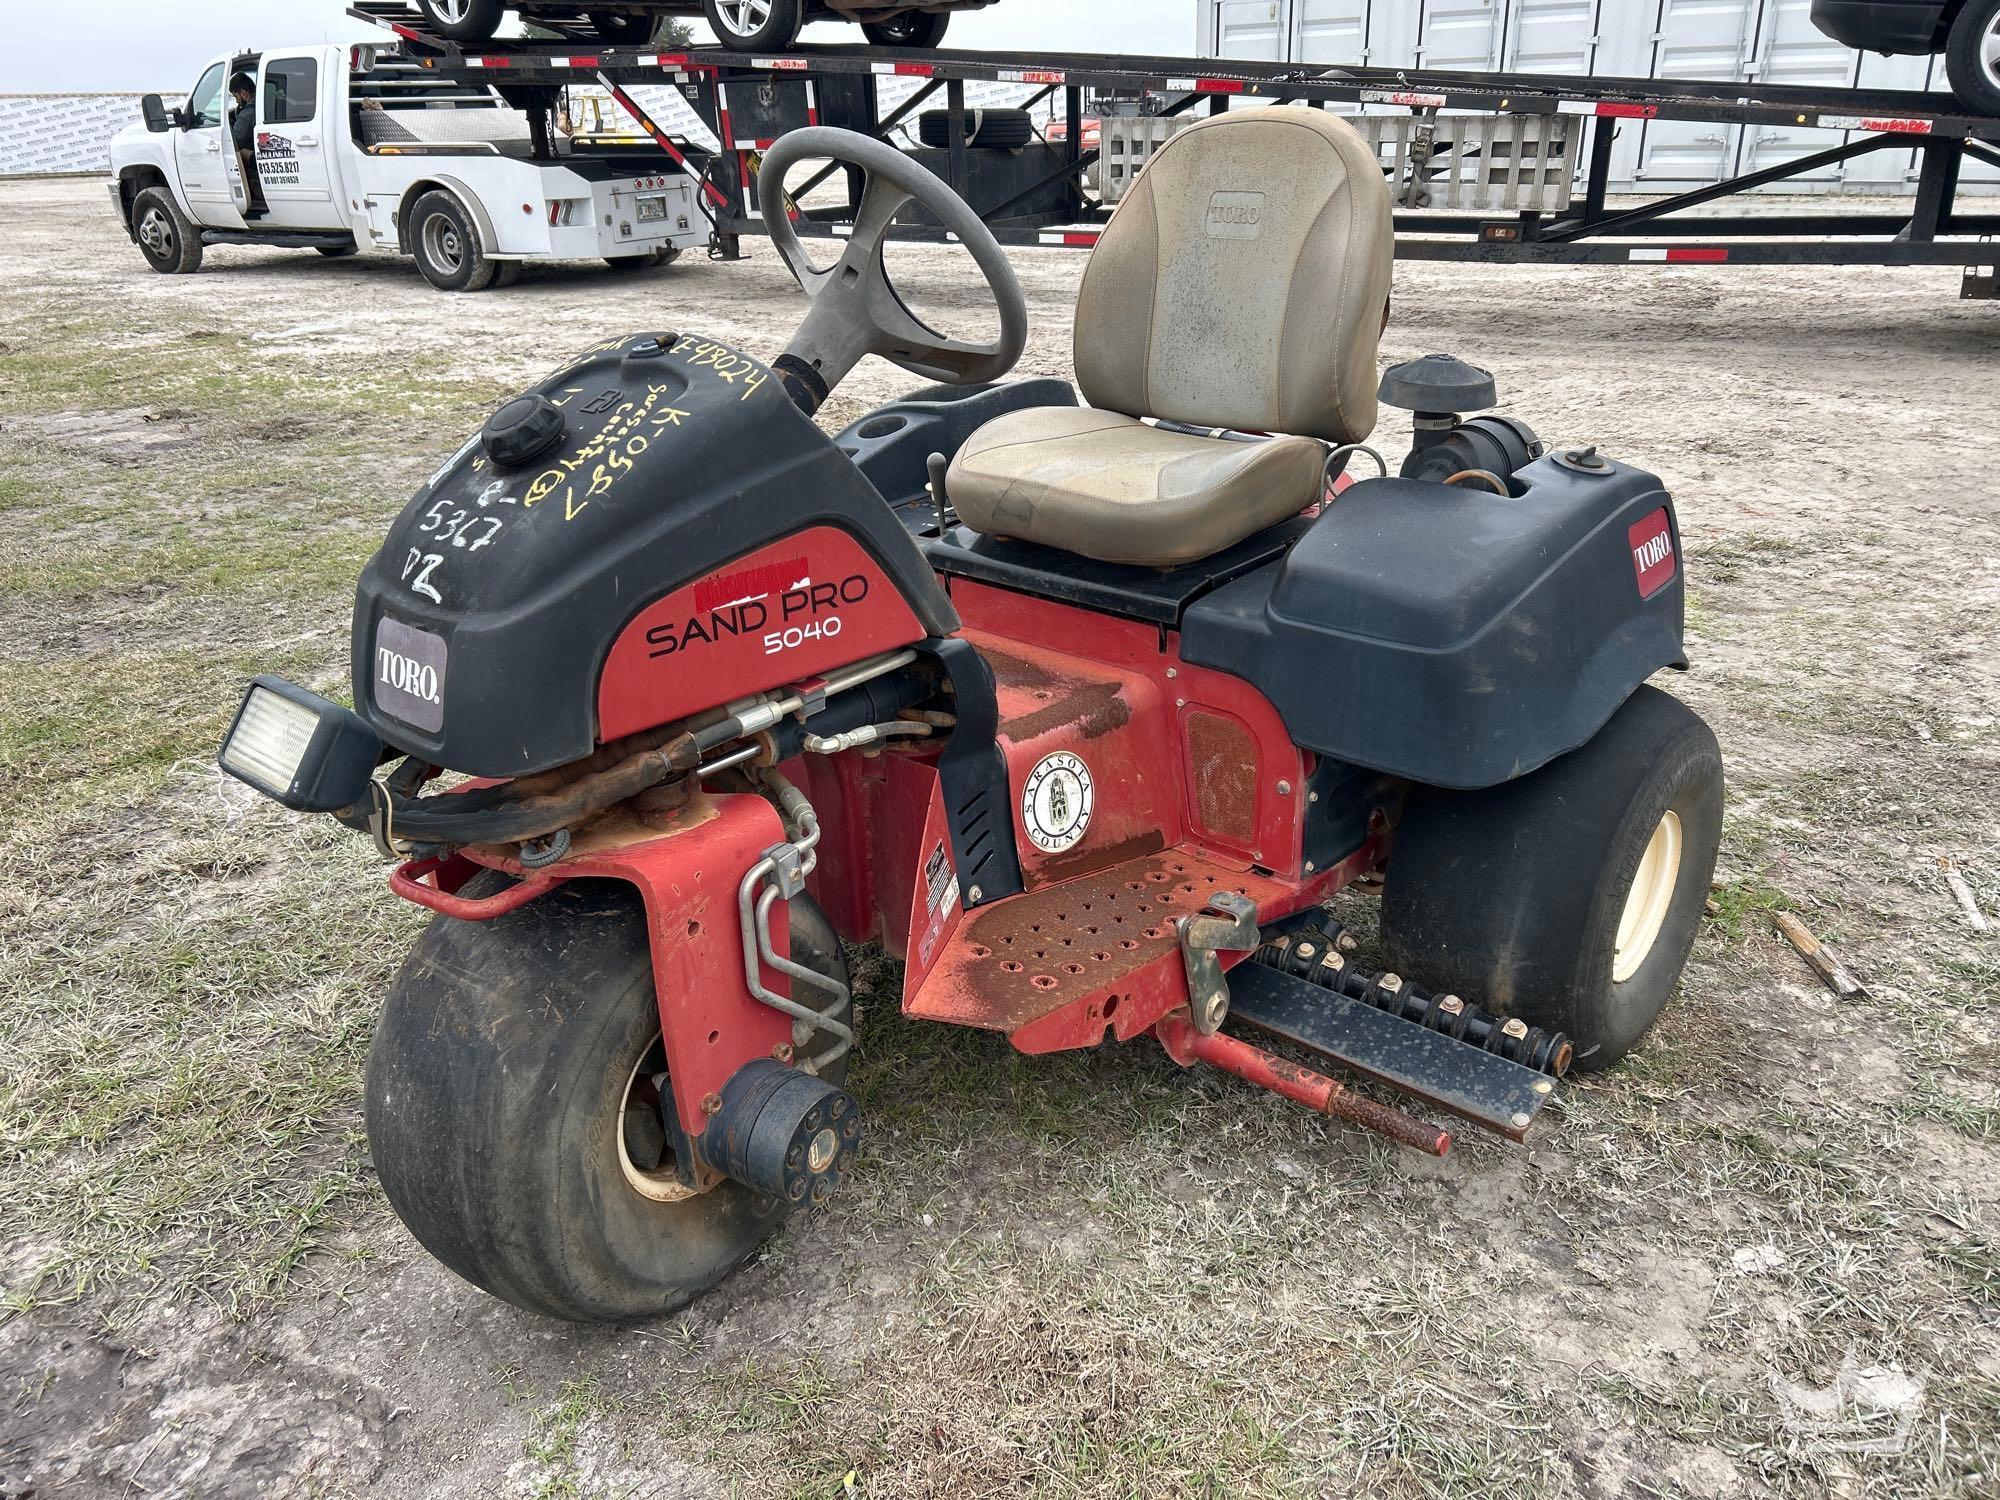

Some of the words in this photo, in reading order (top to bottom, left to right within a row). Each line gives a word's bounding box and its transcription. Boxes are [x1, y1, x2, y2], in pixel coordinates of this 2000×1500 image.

[1212, 206, 1260, 224] TORO
[1634, 531, 1670, 574] TORO
[646, 601, 768, 659] SAND
[782, 574, 869, 622] PRO
[763, 616, 842, 654] 5040
[378, 646, 438, 701] TORO
[1025, 756, 1090, 813] SARASOTA
[1032, 808, 1089, 848] COUNTY
